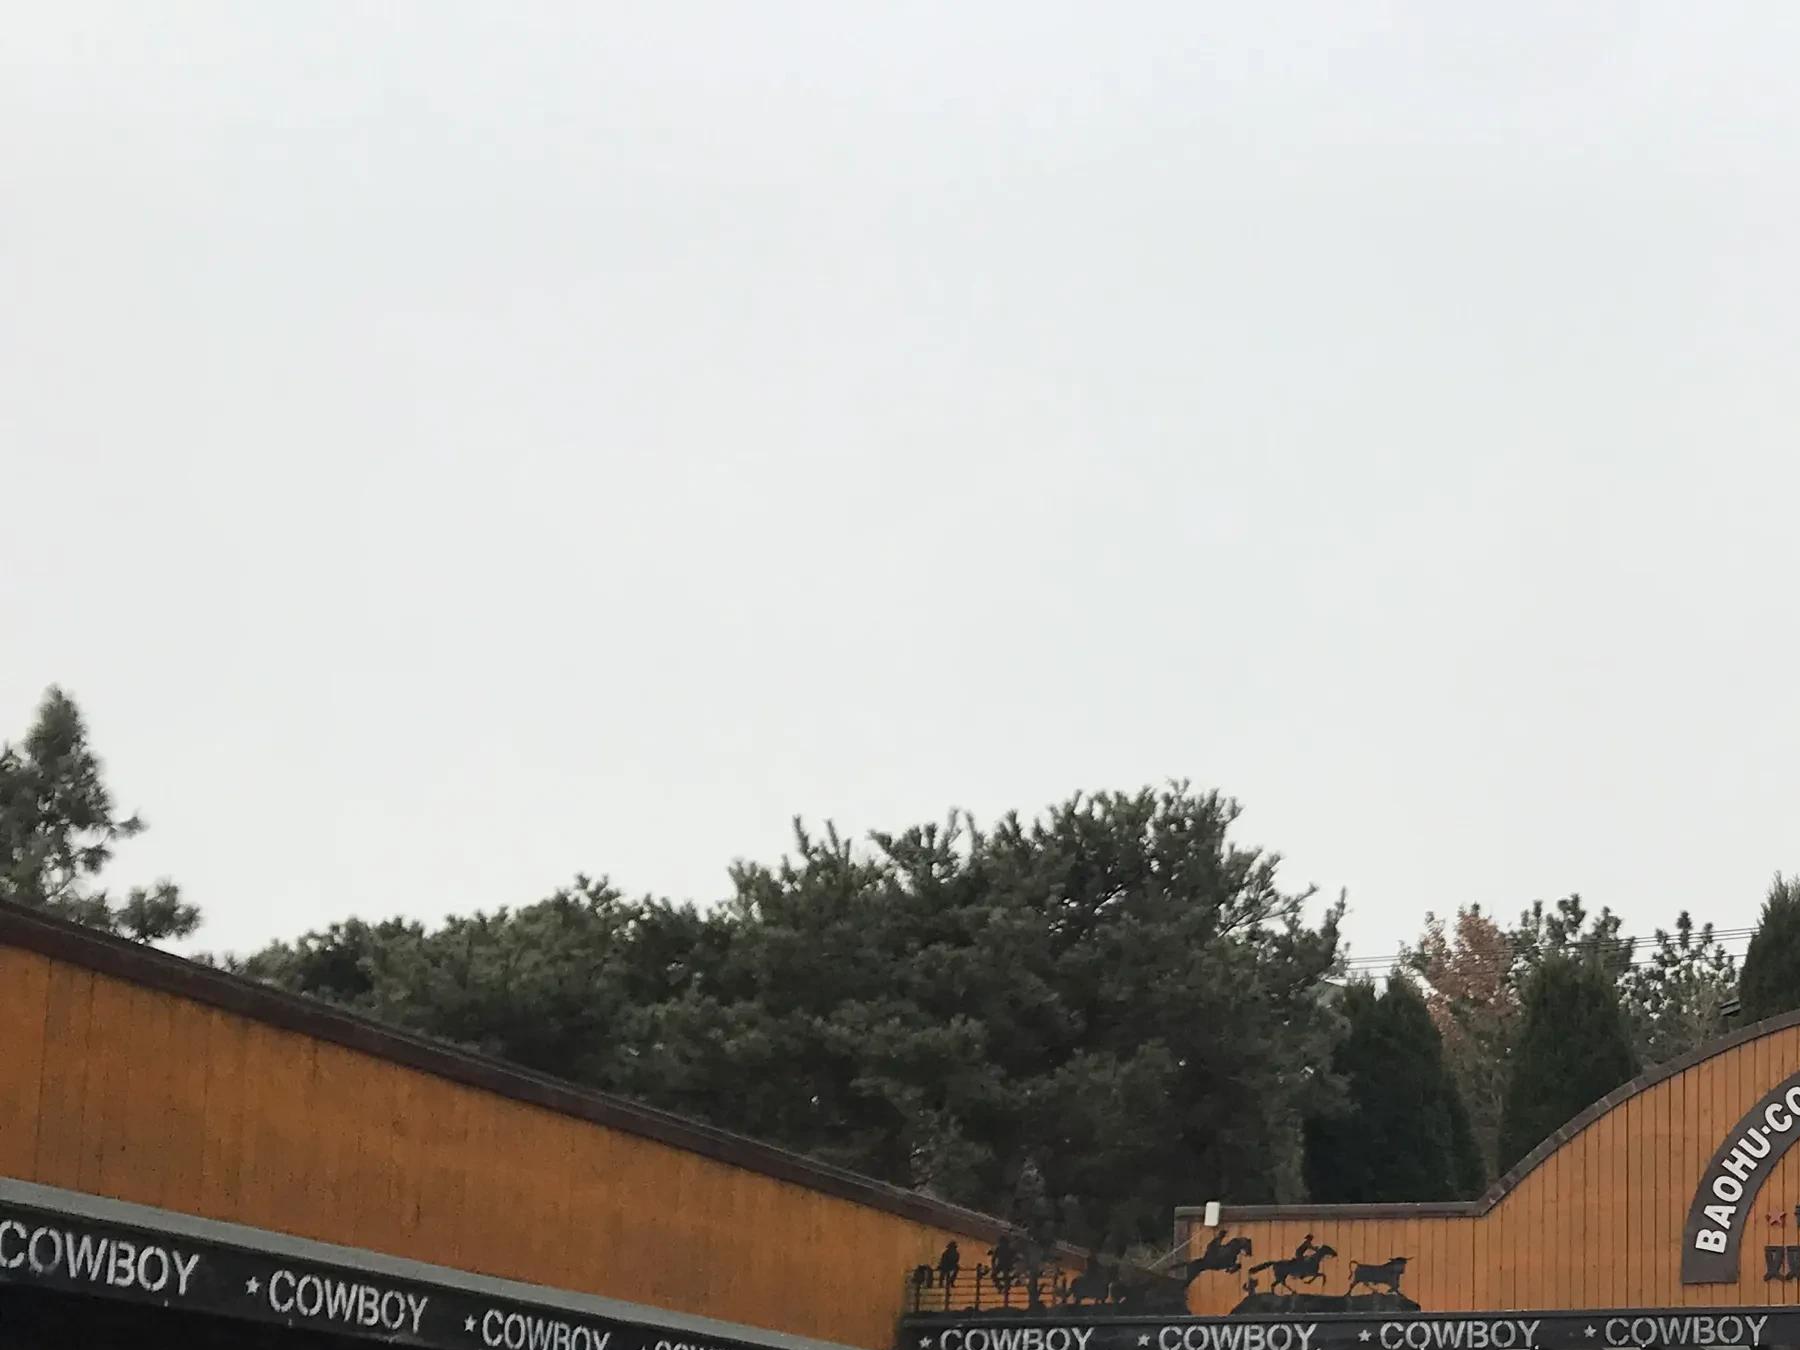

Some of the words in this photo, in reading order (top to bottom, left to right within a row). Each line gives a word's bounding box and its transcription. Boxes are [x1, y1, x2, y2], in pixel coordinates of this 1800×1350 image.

[0, 1219, 200, 1296] COWBOY
[268, 1269, 429, 1334] COWBOY
[1379, 1319, 1541, 1350] COWBOY
[1604, 1314, 1769, 1346] COWBOY
